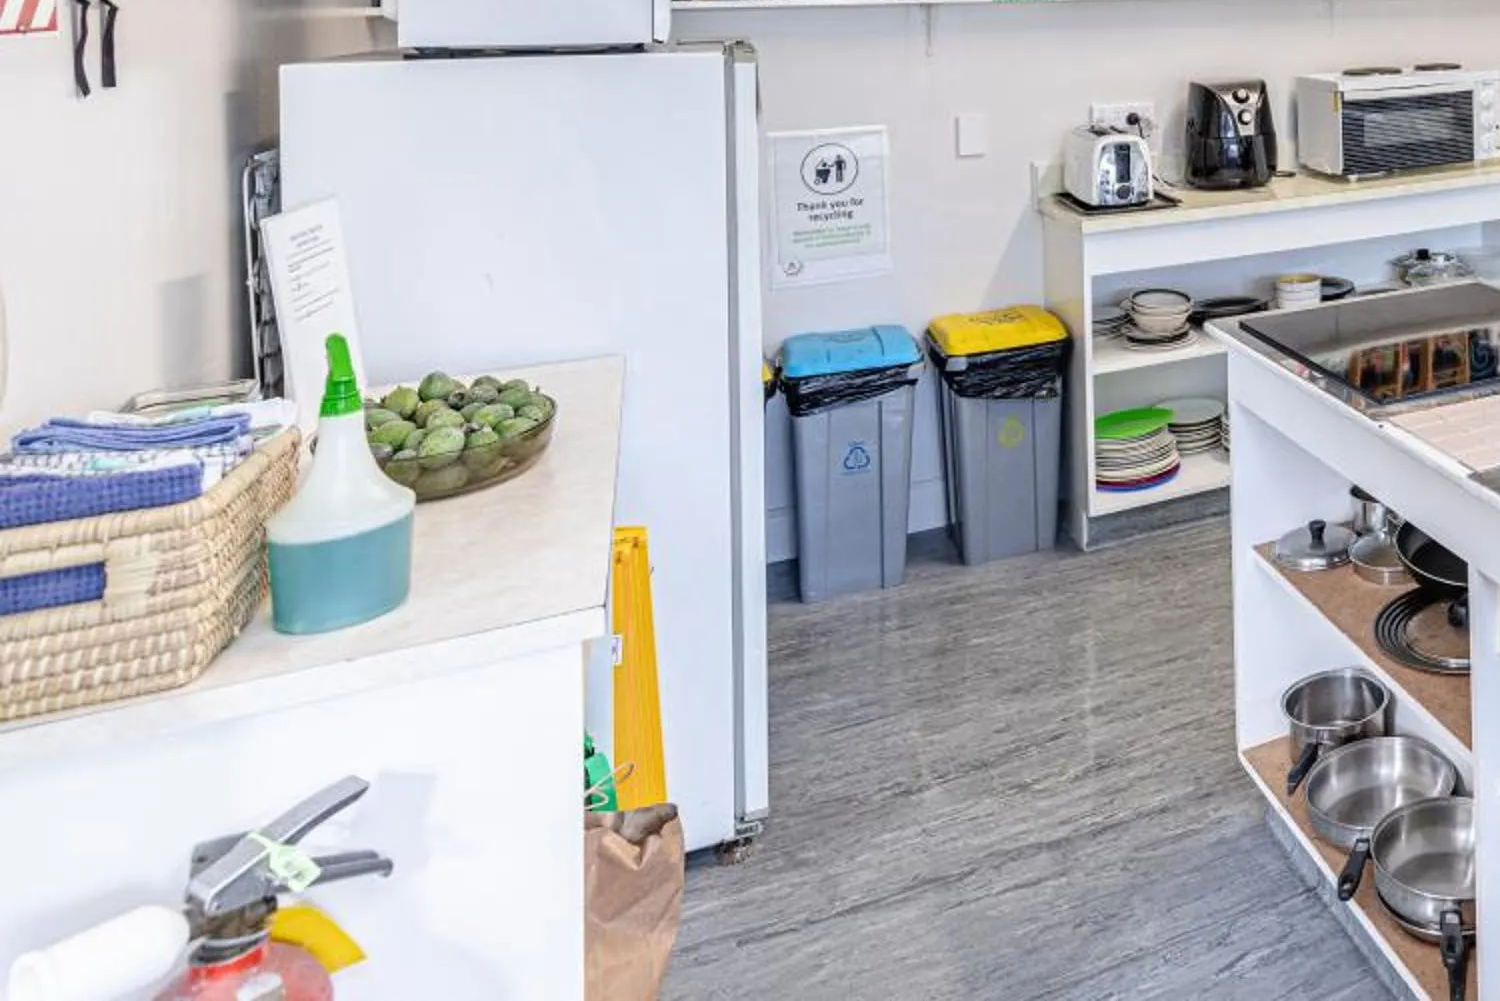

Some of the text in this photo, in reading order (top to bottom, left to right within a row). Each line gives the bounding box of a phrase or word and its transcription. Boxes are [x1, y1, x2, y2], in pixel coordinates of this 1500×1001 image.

[797, 197, 865, 212] Thank you for
[808, 209, 854, 222] recycling
